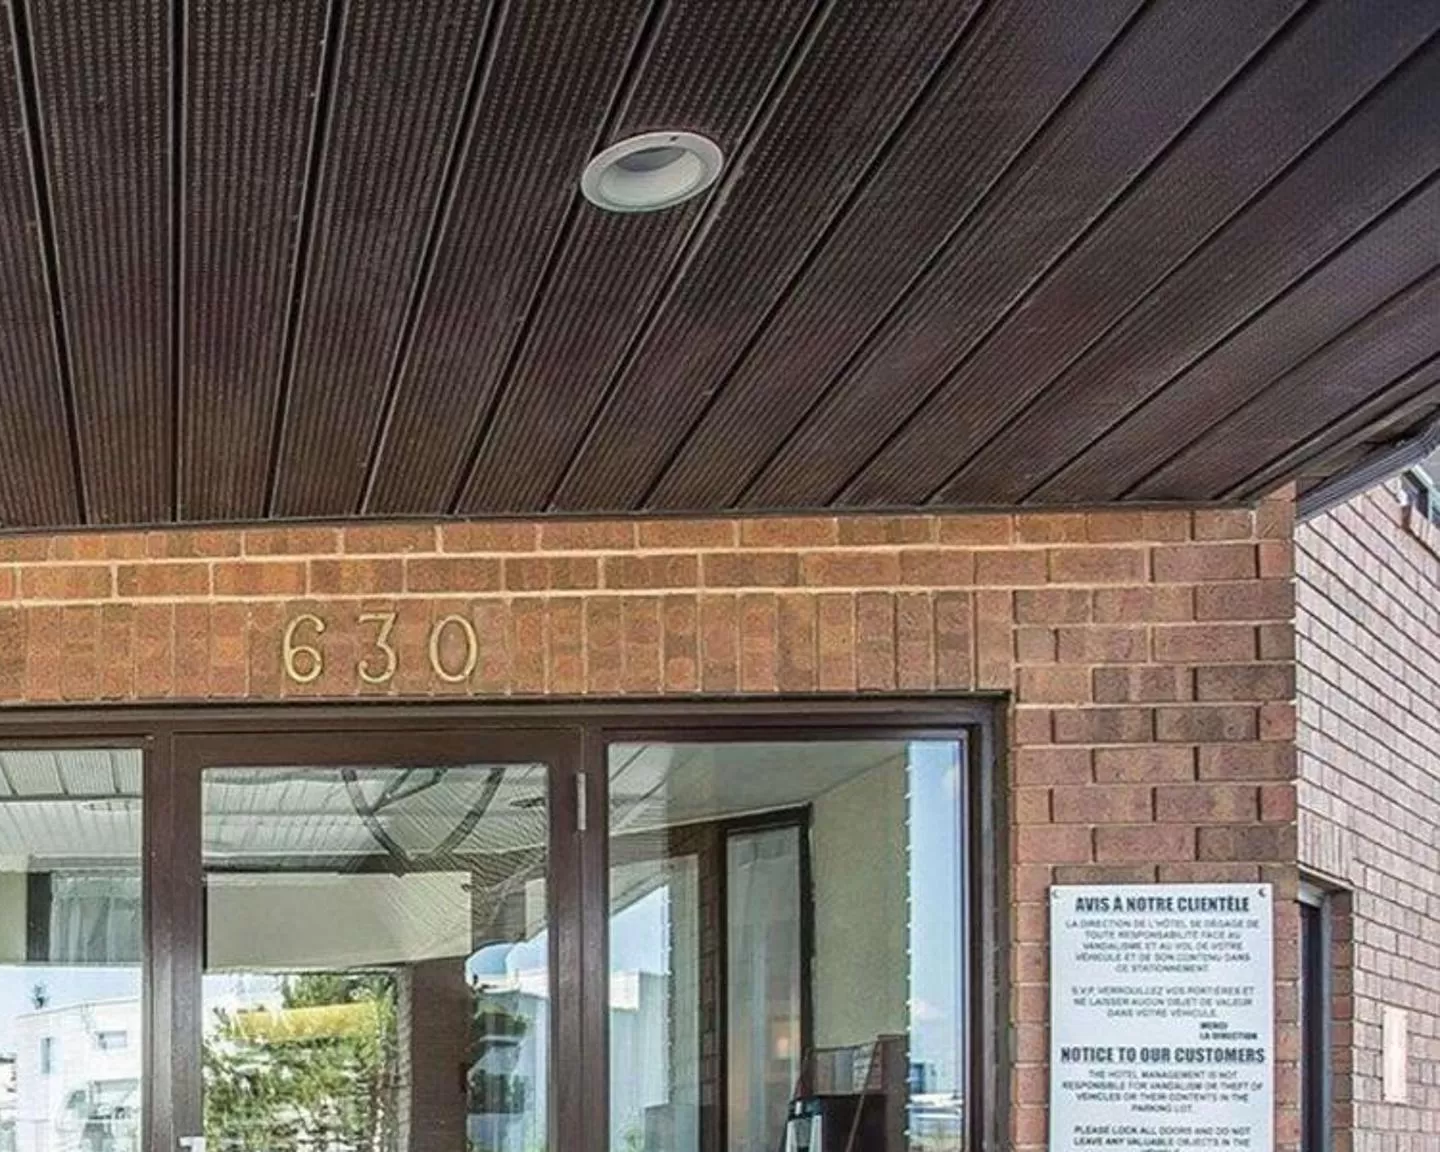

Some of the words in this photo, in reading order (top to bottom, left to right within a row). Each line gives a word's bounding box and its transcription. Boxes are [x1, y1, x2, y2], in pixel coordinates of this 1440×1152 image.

[282, 613, 479, 684] 630
[1075, 896, 1110, 912] AVIS
[1126, 896, 1173, 912] NOTRE
[1080, 919, 1131, 928] DIRECTION
[1082, 942, 1141, 950] VANDALISME
[1211, 942, 1243, 950] VOTRE
[1089, 998, 1129, 1006] LAISSER
[1131, 998, 1165, 1006] AUCUN
[1167, 998, 1197, 1006] OBJET
[1215, 998, 1253, 1006] VALEUR
[1107, 1009, 1133, 1018] DANS
[1136, 1009, 1167, 1018] VOTRE
[1212, 1032, 1258, 1040] DIRECTION
[1061, 1047, 1114, 1063] NOTICE
[1118, 1047, 1136, 1063] TO
[1140, 1047, 1171, 1063] OUR
[1174, 1047, 1265, 1063] CUSTOMERS
[1088, 1070, 1105, 1078] THE
[1109, 1070, 1137, 1078] HOTEL
[1141, 1070, 1206, 1078] MANAGEMENT
[1219, 1070, 1238, 1078] NOT
[1062, 1081, 1125, 1090] RESPONSIBLE
[1128, 1081, 1147, 1090] FOR
[1149, 1081, 1202, 1090] VANDALISM
[1220, 1081, 1249, 1090] THEFT
[1076, 1093, 1121, 1101] VEHICLES
[1140, 1093, 1166, 1101] THEIR
[1168, 1093, 1217, 1101] CONTENTS
[1231, 1093, 1249, 1101] THE
[1131, 1104, 1172, 1112] PARKING
[1073, 1126, 1110, 1135] PLEASE
[1112, 1126, 1137, 1135] LOCK
[1140, 1126, 1157, 1135] ALL
[1159, 1126, 1193, 1135] DOORS
[1194, 1126, 1214, 1135] AND
[1232, 1126, 1251, 1135] NOT
[1073, 1138, 1103, 1146] LEAVE
[1105, 1138, 1124, 1146] ANY
[1127, 1138, 1174, 1146] VALUABLE
[1177, 1138, 1219, 1146] OBJECTS
[1232, 1138, 1251, 1146] THE
